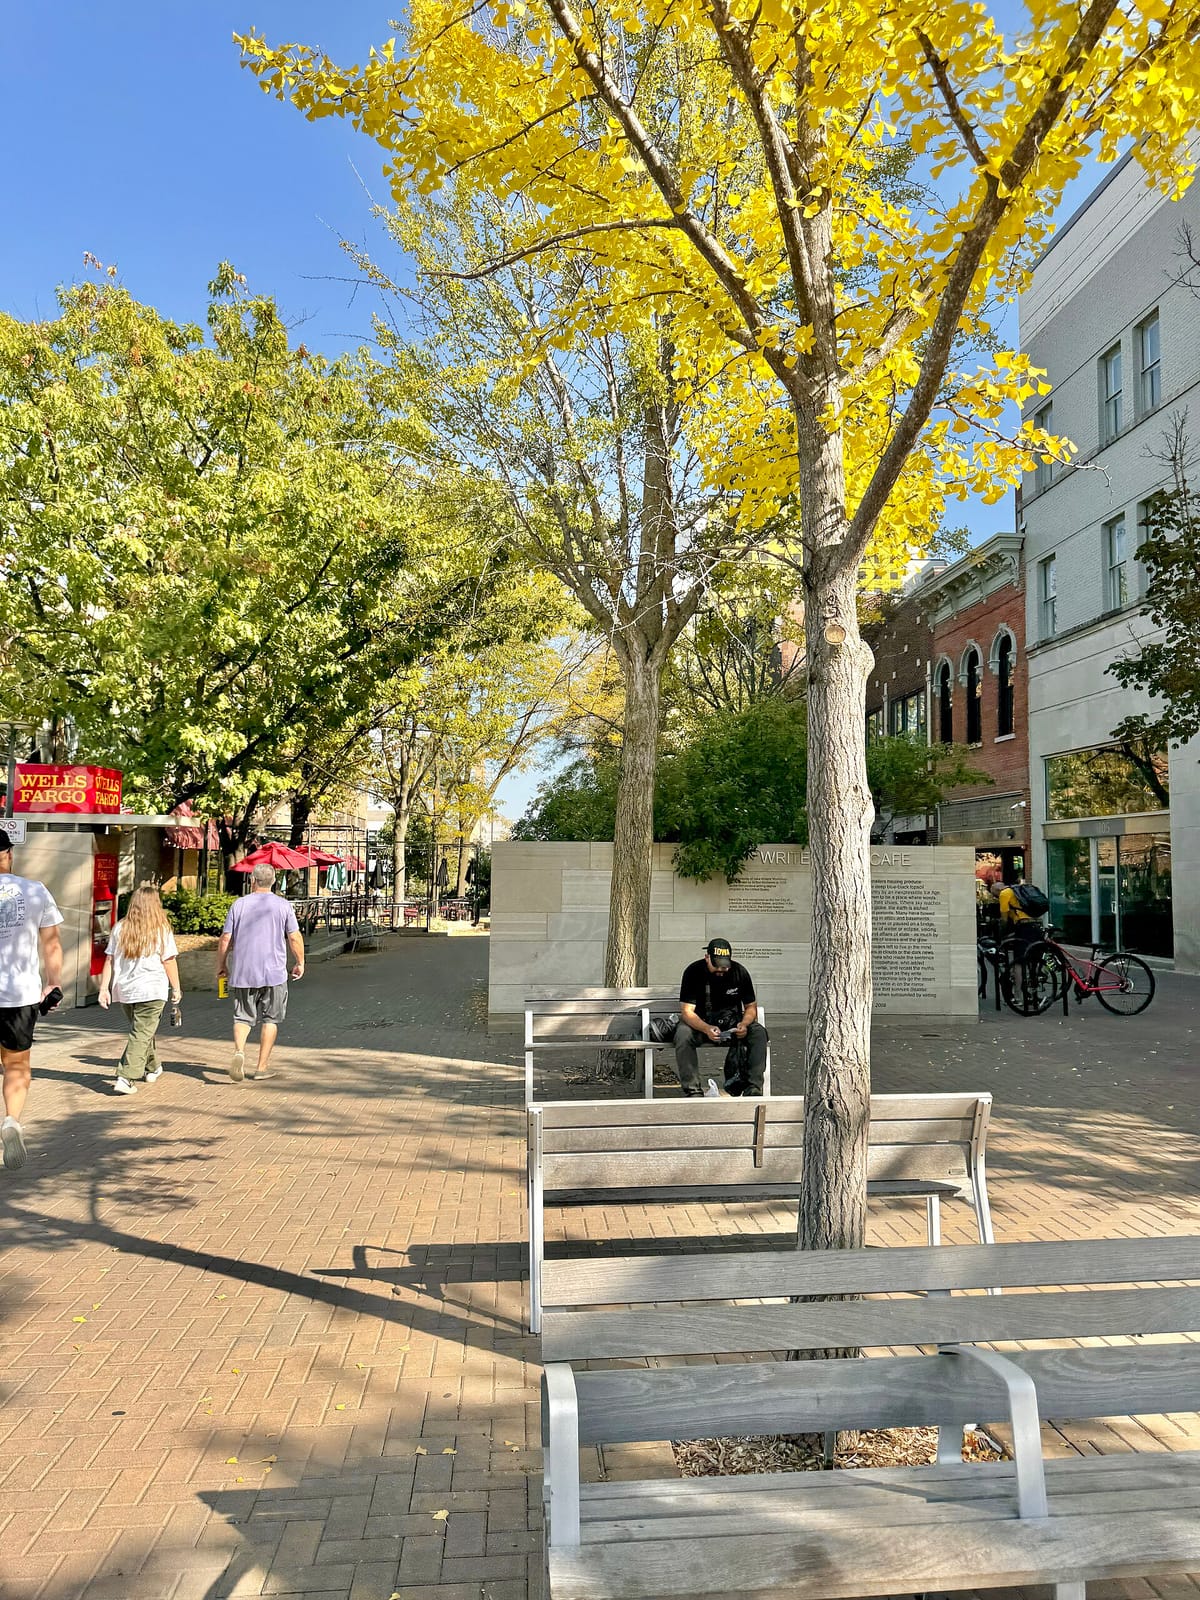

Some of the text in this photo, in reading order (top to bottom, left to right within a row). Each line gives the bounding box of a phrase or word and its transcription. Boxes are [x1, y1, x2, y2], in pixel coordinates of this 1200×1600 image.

[18, 774, 87, 788] WELLS
[95, 776, 119, 792] WELLS
[19, 789, 86, 803] FARGO
[95, 791, 119, 806] FARGO
[760, 850, 912, 866] WRITE CAFE
[713, 946, 731, 957] IOWA
